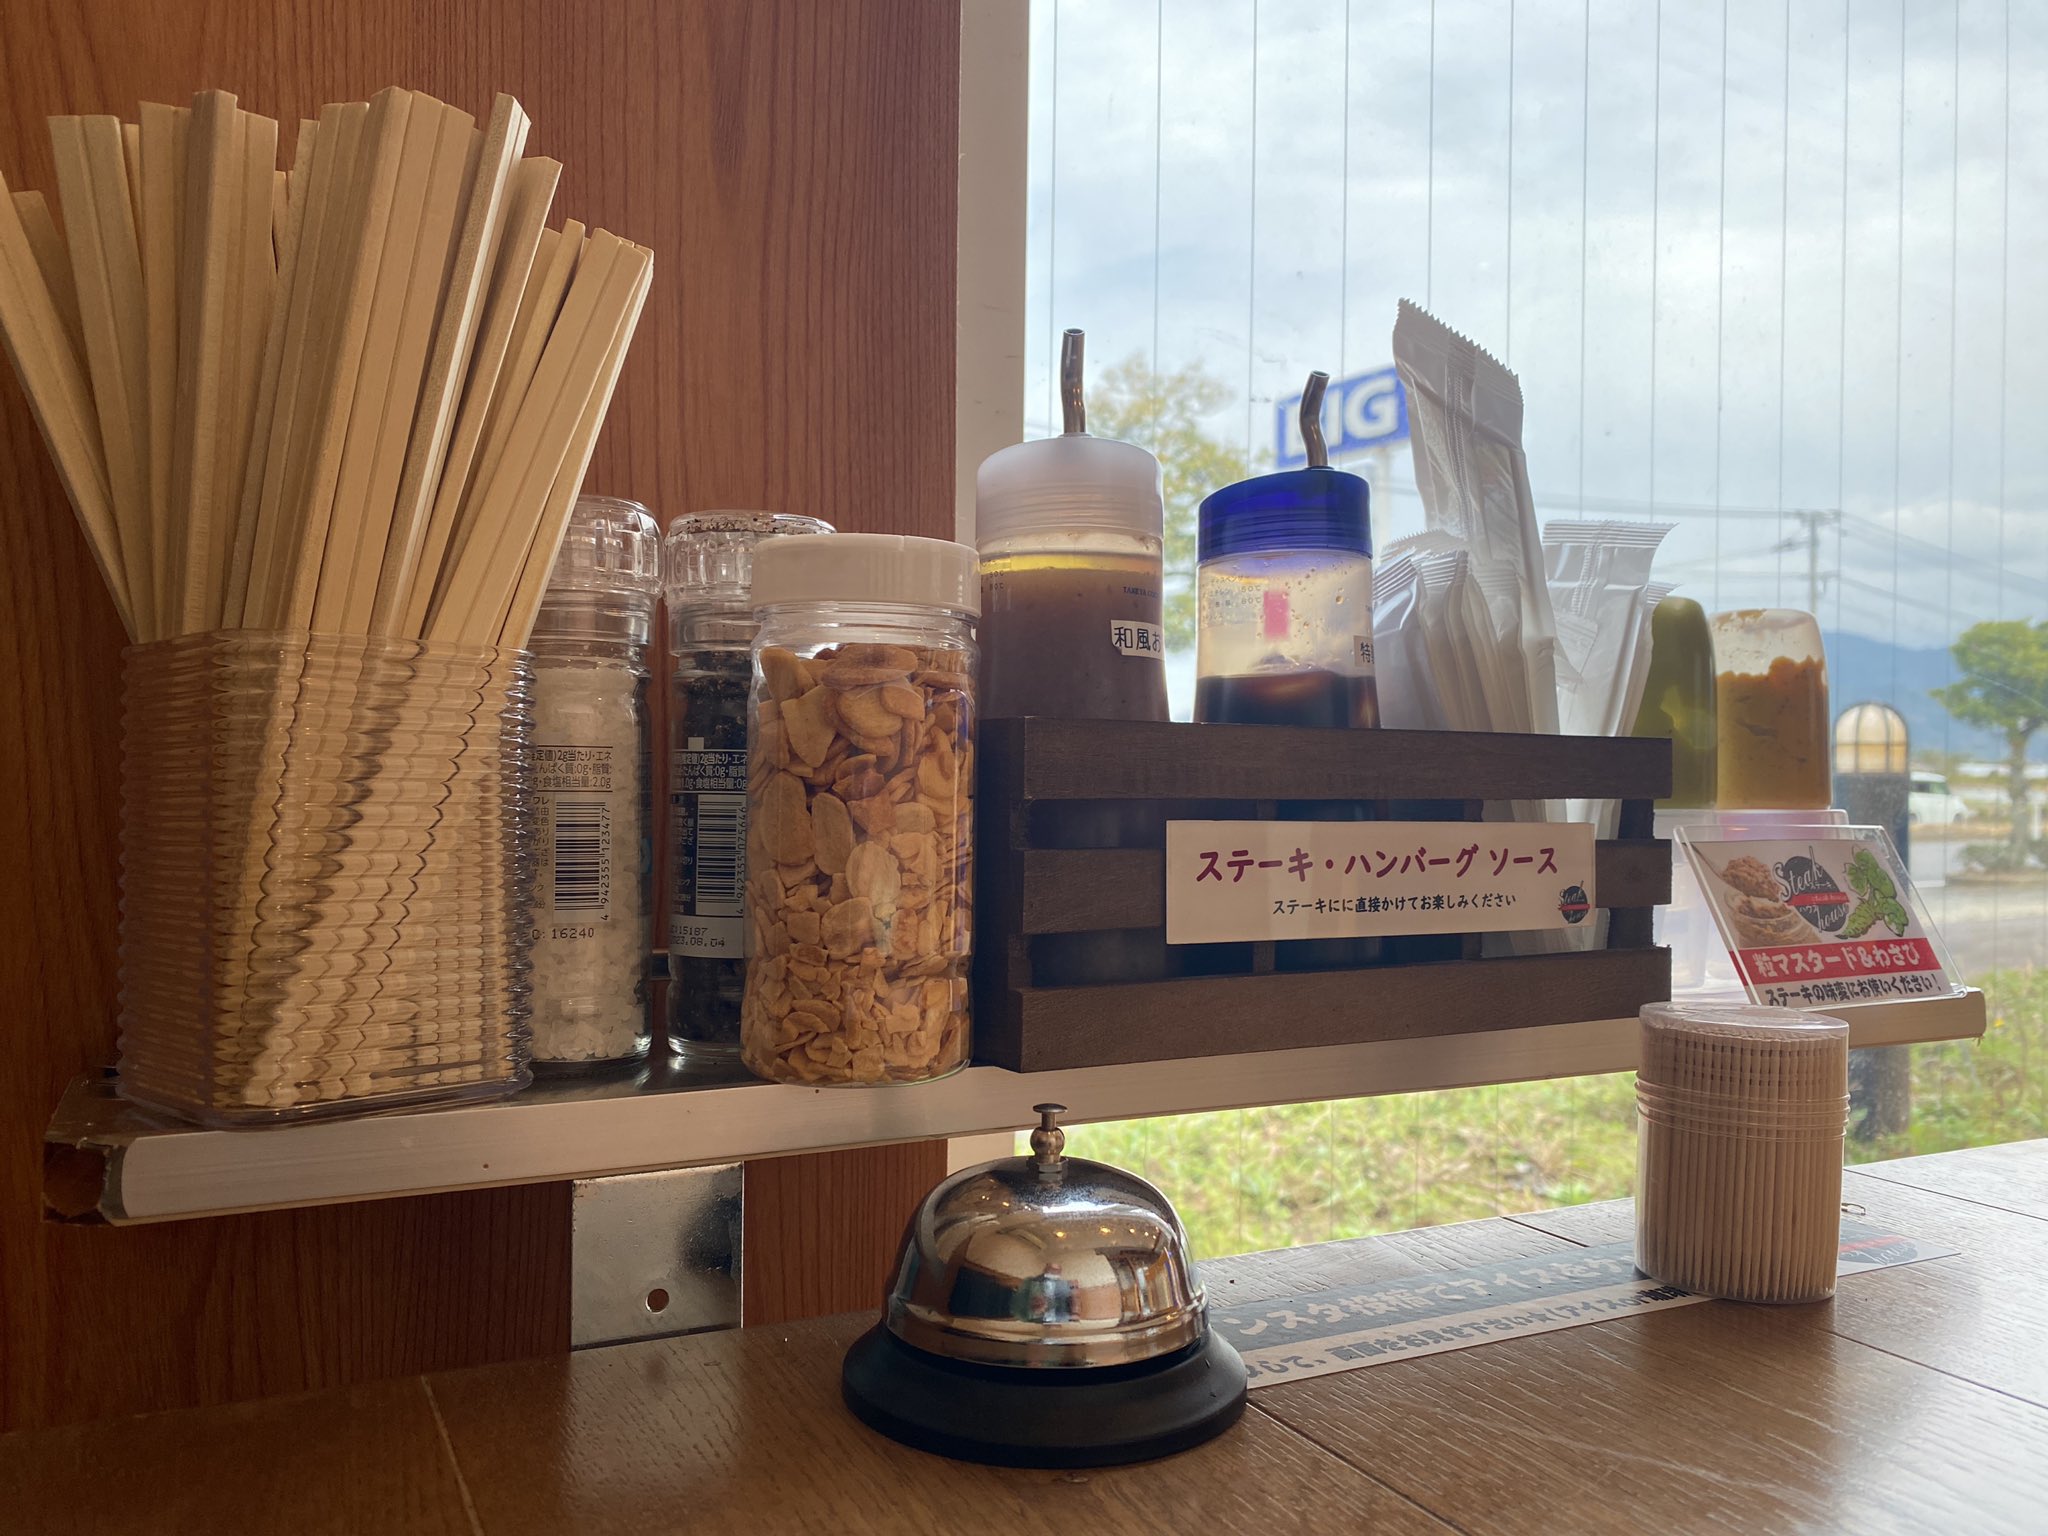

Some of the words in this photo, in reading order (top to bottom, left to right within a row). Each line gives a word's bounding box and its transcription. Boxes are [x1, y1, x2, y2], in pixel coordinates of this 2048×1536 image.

[1489, 847, 1559, 877] ソース
[1272, 893, 1517, 915] ステーキにに直接かけてお楽しみください
[551, 927, 595, 940] 16240
